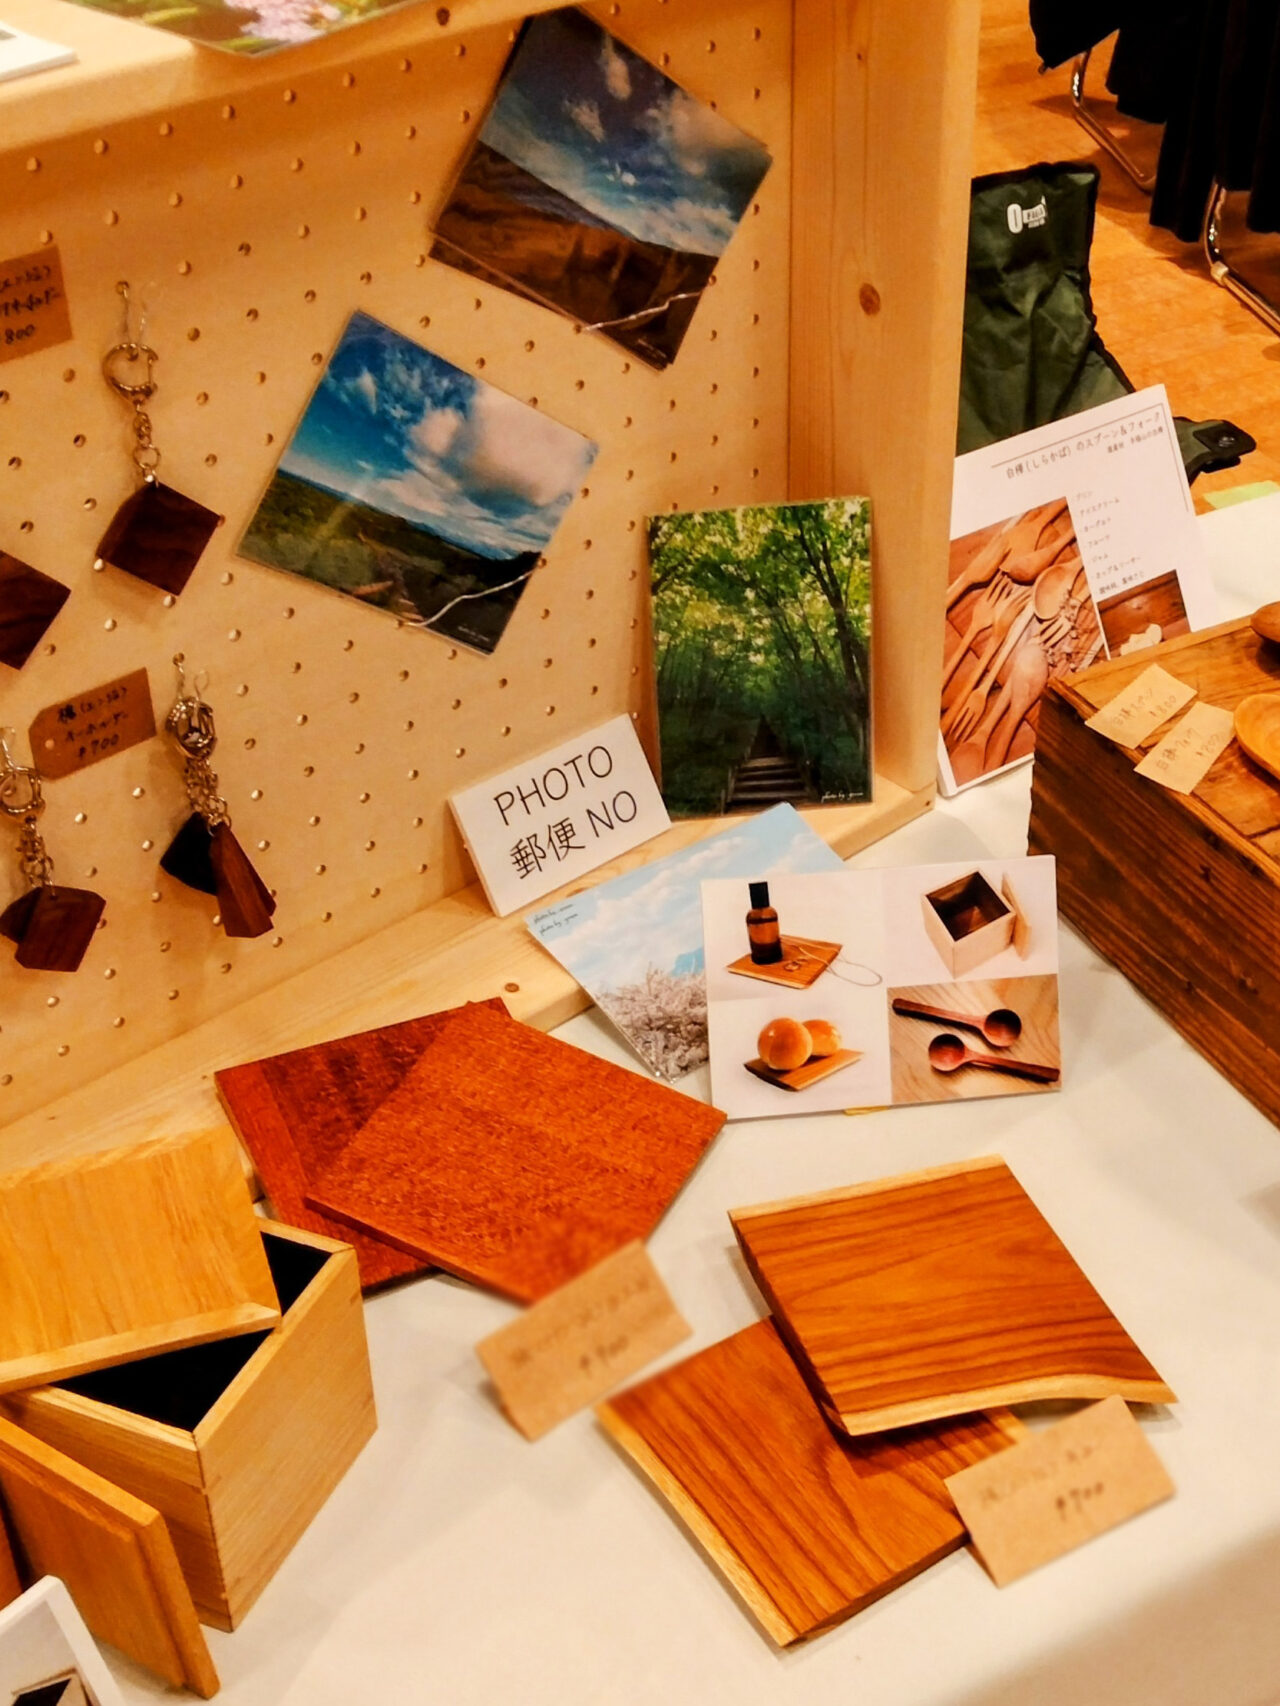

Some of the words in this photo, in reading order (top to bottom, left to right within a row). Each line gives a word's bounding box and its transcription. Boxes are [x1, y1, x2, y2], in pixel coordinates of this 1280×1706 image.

[493, 745, 613, 827] PHOTO
[510, 817, 587, 880] 郵便
[586, 790, 638, 838] NO
